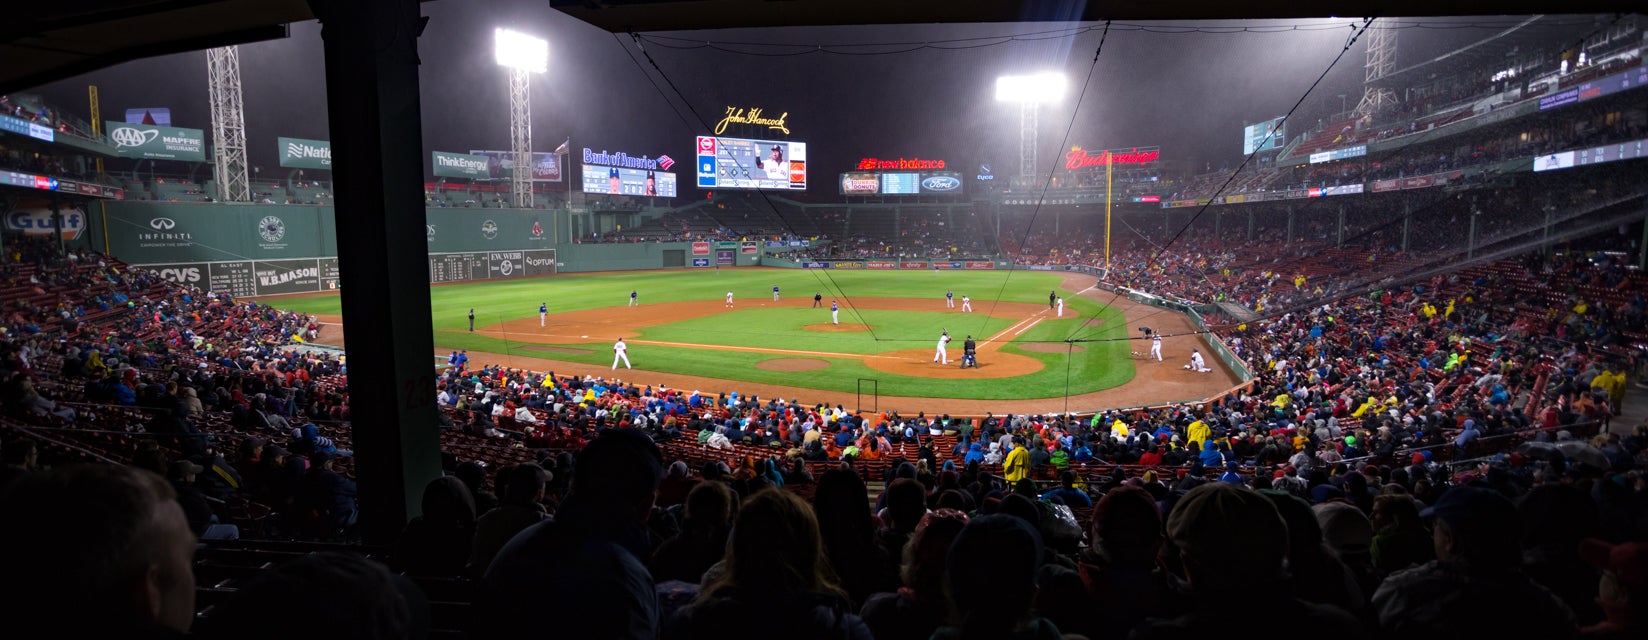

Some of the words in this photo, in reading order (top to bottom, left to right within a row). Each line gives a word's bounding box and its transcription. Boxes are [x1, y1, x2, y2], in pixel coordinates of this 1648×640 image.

[715, 106, 746, 135] John
[745, 107, 790, 135] Hancock
[115, 127, 143, 146] AAA
[162, 136, 201, 146] MAPFRE
[583, 147, 610, 166] Bank
[609, 152, 621, 166] of
[621, 152, 657, 170] America
[899, 158, 946, 169] balance
[1064, 148, 1160, 169] Budweiser
[929, 179, 952, 189] Ford
[503, 252, 522, 260] WEBB
[532, 258, 554, 266] OPTUM
[160, 267, 201, 283] CVS
